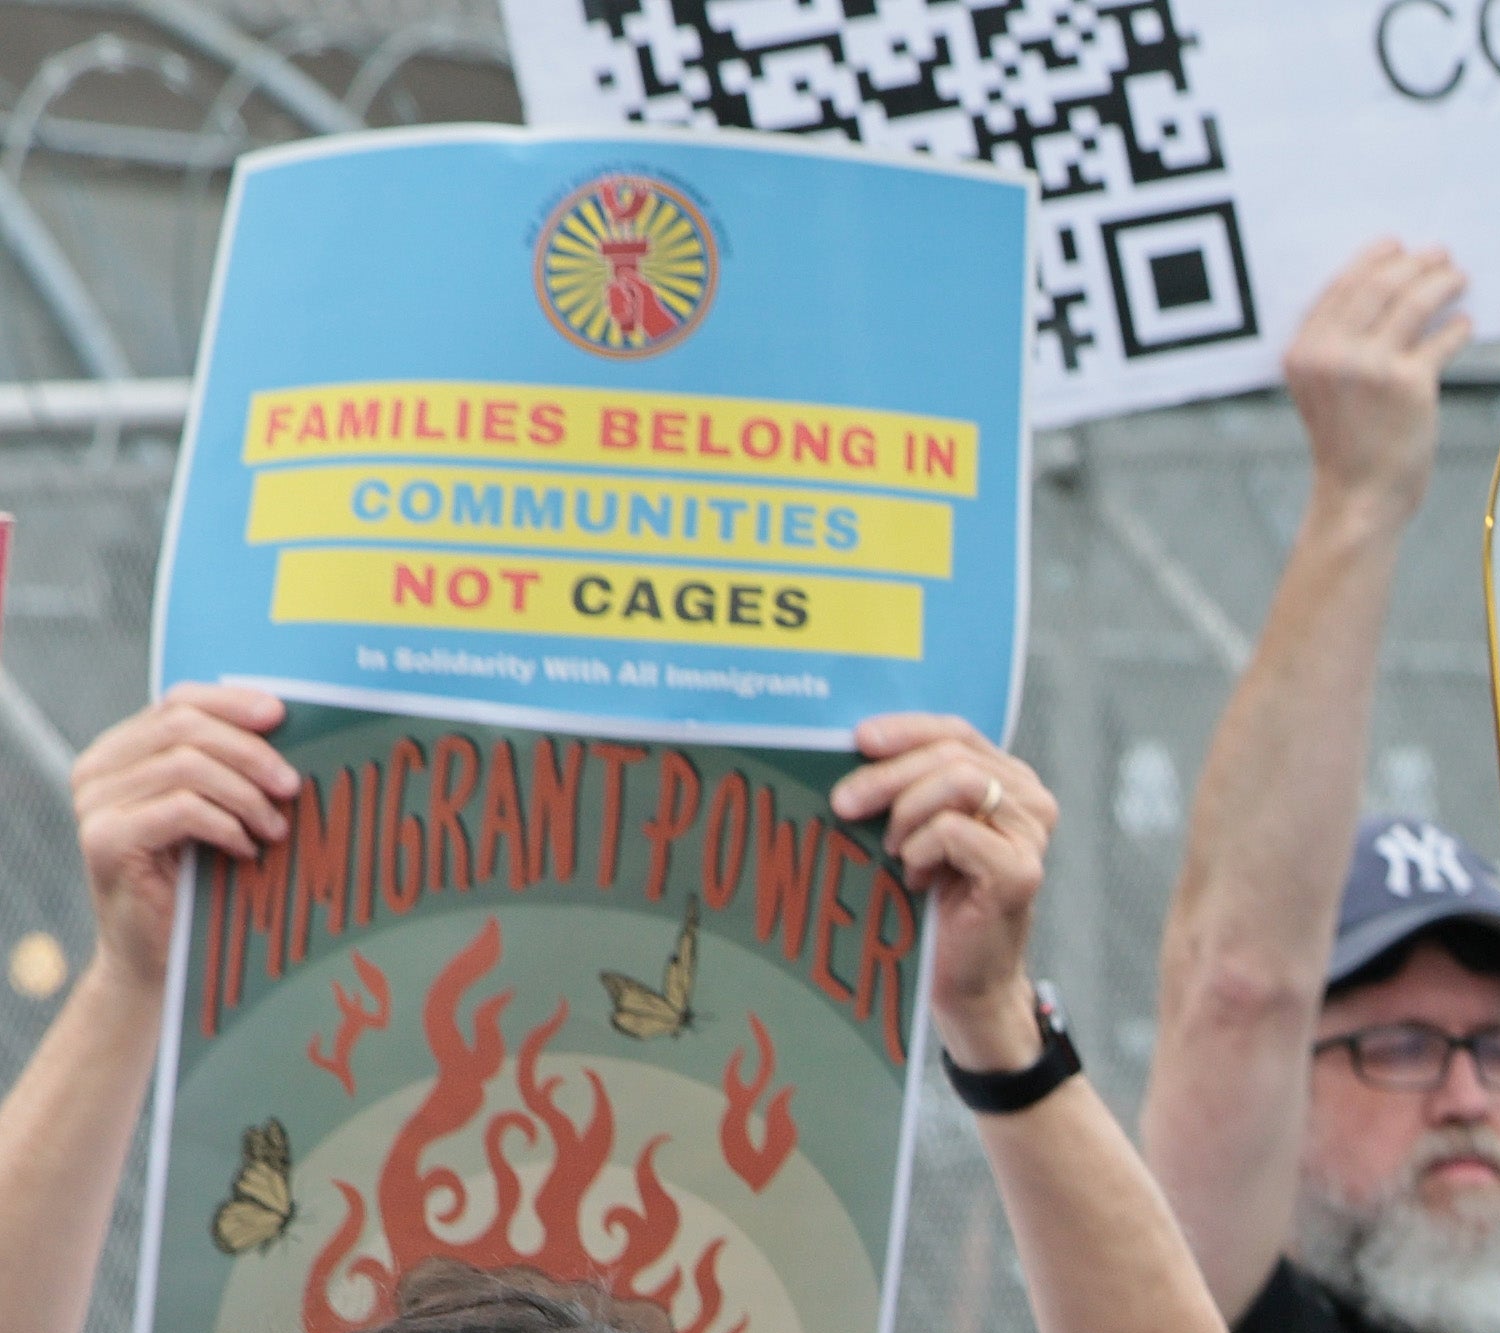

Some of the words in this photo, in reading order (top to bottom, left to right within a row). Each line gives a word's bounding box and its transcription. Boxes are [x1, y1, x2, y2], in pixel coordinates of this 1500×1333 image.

[262, 398, 568, 448] FAMILIES
[600, 408, 880, 471] BELONG
[902, 433, 959, 480] IN
[350, 480, 861, 551] COMMUNITIES
[391, 562, 542, 614] NOT
[570, 576, 812, 630] CAGES
[356, 647, 388, 671] In
[394, 650, 536, 684] Solidarity
[542, 656, 612, 685] With
[617, 661, 660, 688] All
[665, 665, 830, 700] Immigrants
[641, 748, 914, 1065] POWER
